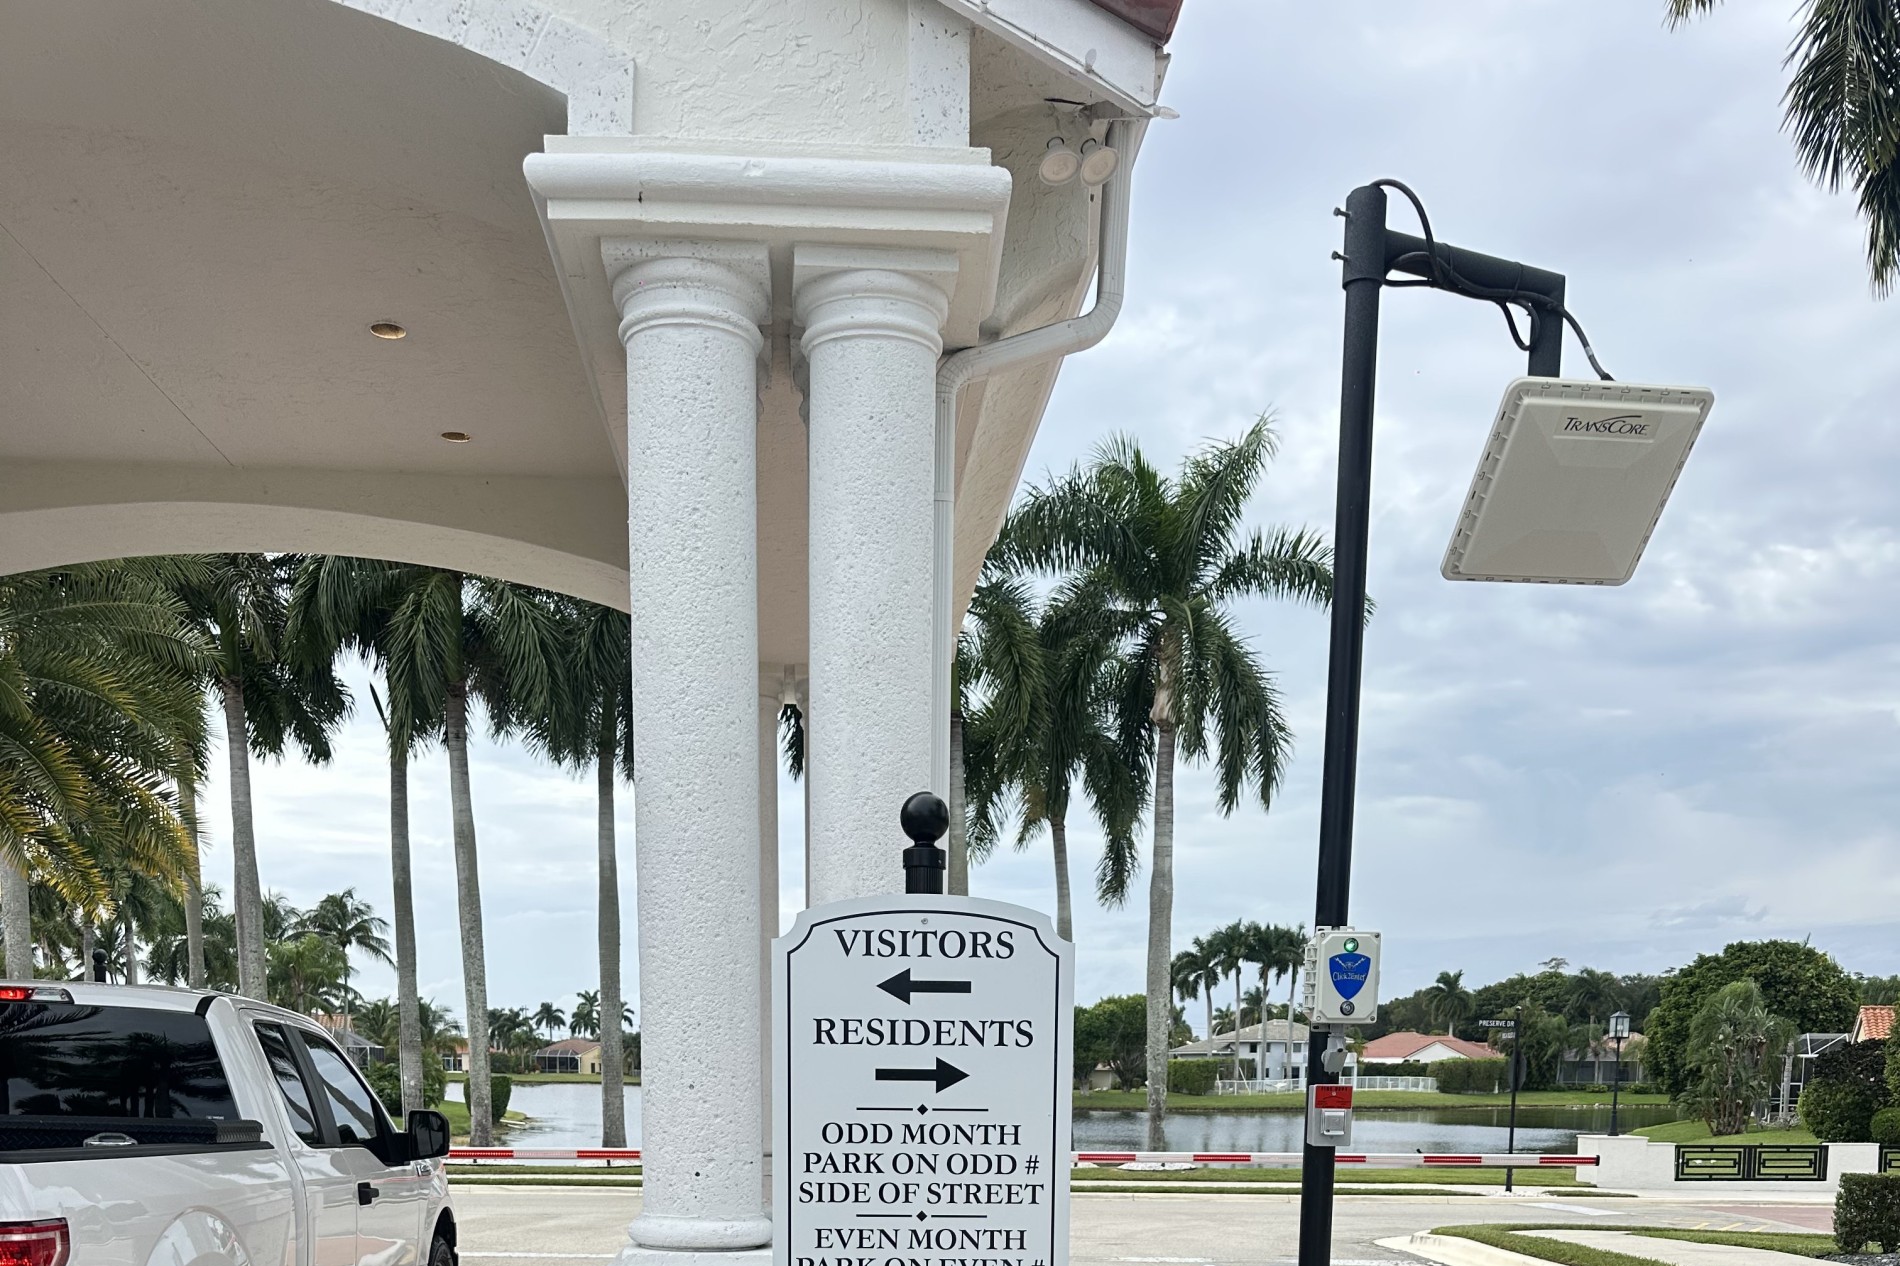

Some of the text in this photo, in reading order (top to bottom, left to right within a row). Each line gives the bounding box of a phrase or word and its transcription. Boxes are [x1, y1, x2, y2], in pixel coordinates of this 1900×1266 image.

[834, 929, 1015, 959] VISITORS
[813, 1018, 1034, 1047] RESIDENTS
[1479, 1019, 1506, 1027] PRESERVE
[821, 1122, 1021, 1145] ODD MONTH
[803, 1152, 1039, 1175] PARK ON ODD #
[799, 1182, 1044, 1205] SIDE OF STREET
[815, 1229, 1027, 1250] EVEN MONTH
